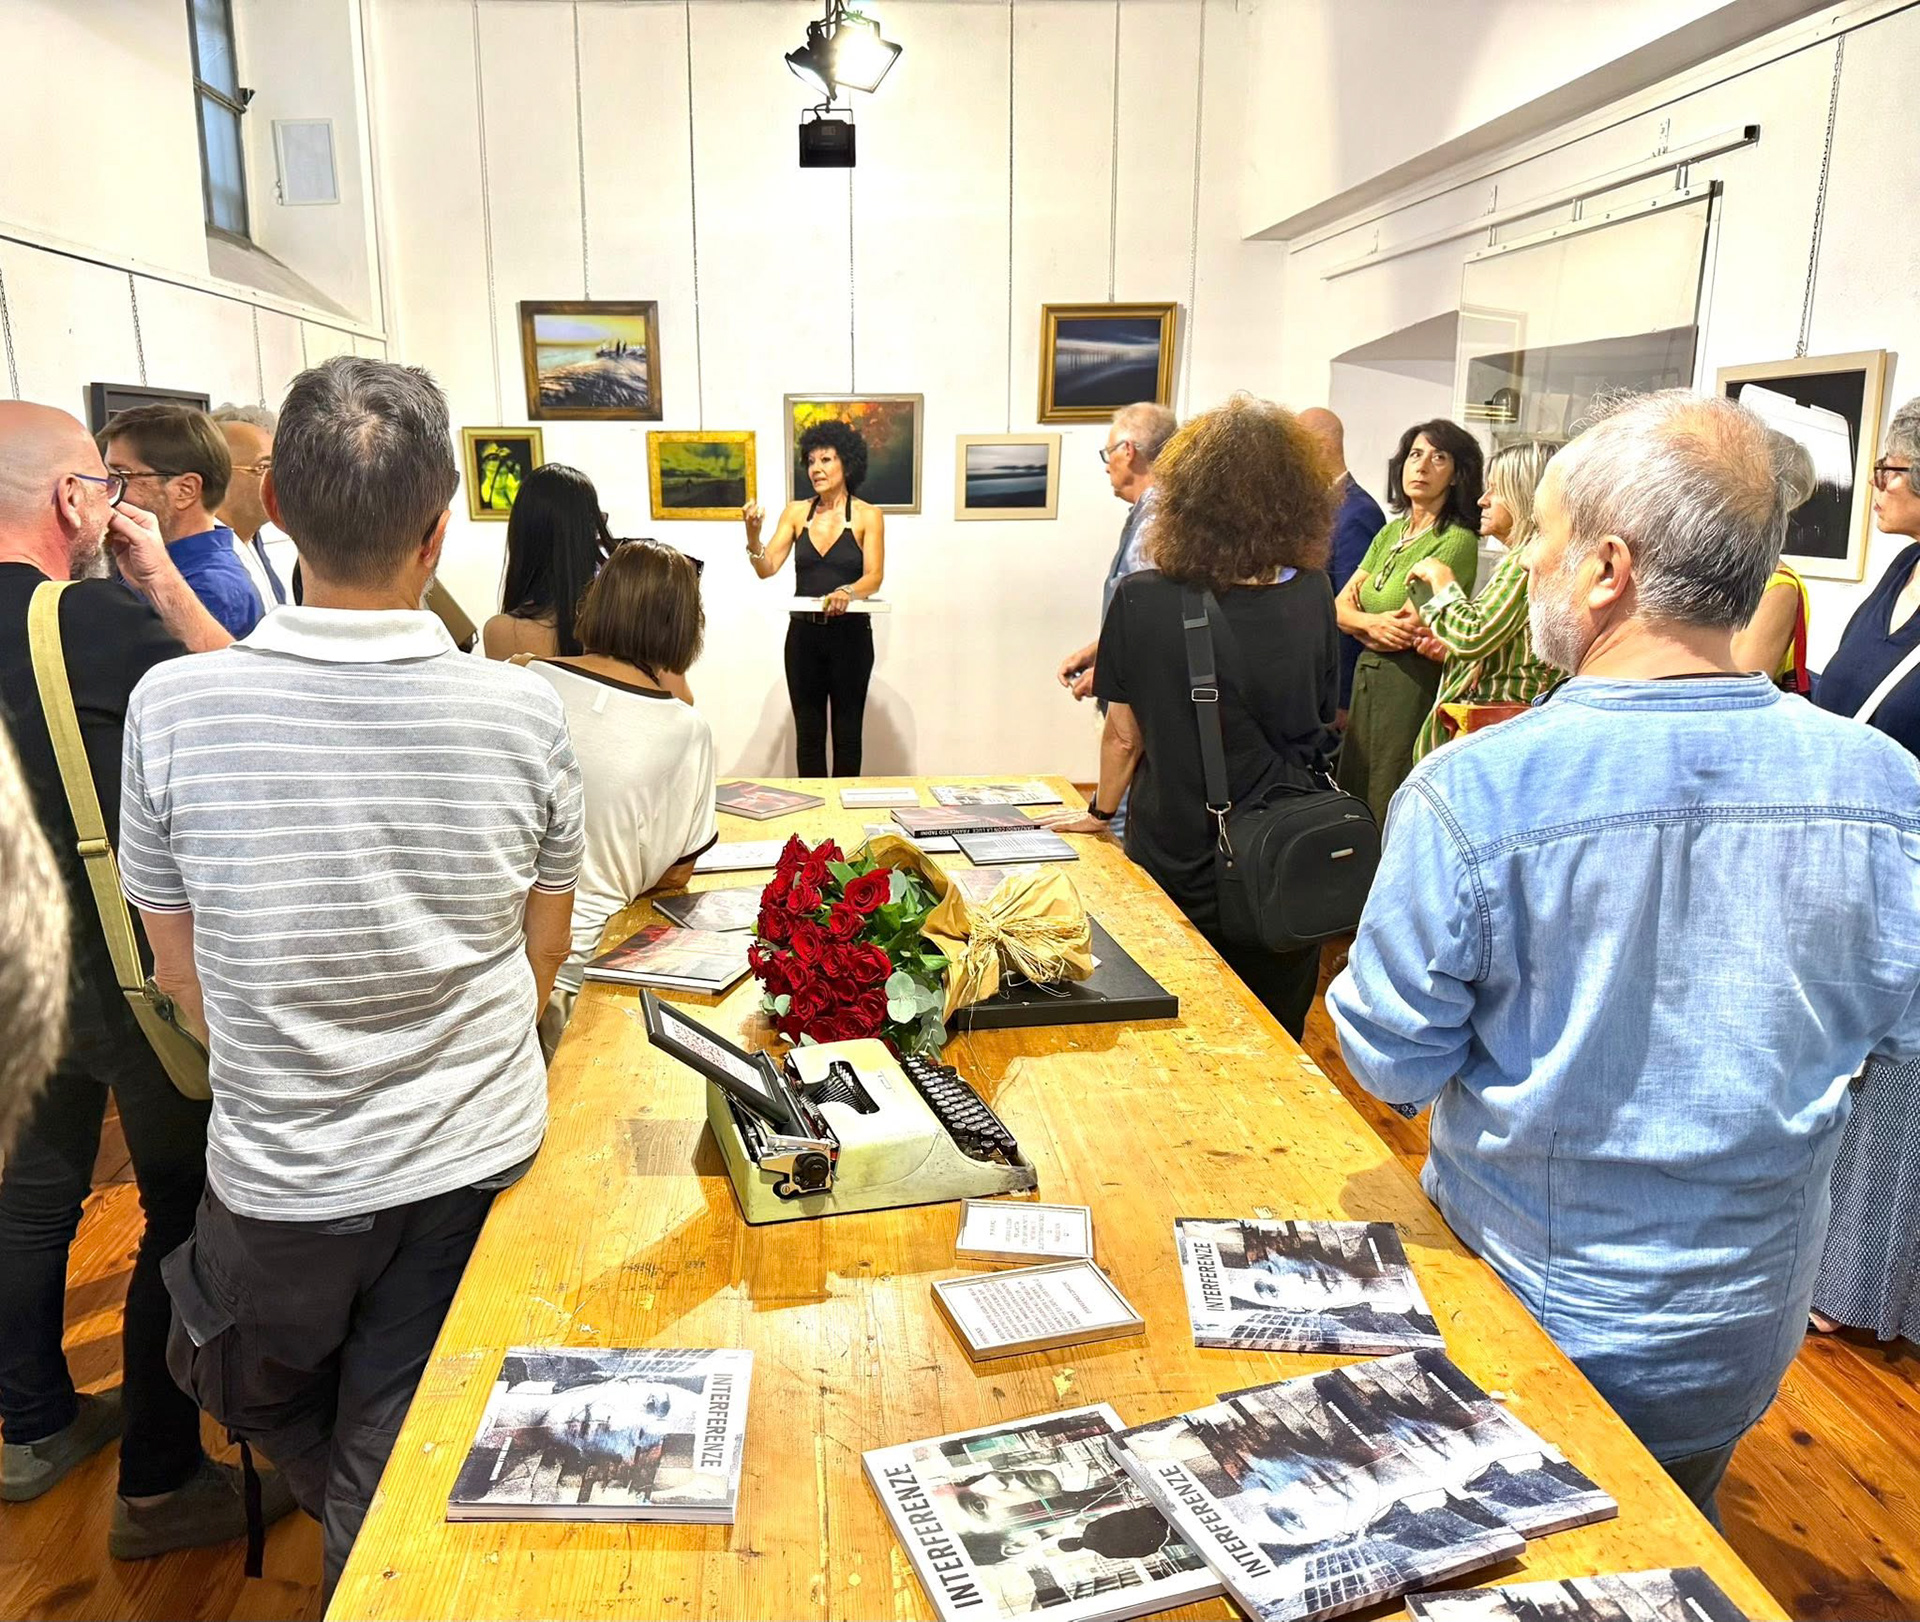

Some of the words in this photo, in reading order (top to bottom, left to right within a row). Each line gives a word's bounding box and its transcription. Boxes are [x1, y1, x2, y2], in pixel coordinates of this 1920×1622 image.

[1194, 1242, 1225, 1312] INTERFERENZE
[700, 1373, 734, 1468] INTERFERENZE
[884, 1463, 984, 1609] INTERFERENZE
[1158, 1464, 1271, 1578] INTERFERENZE
